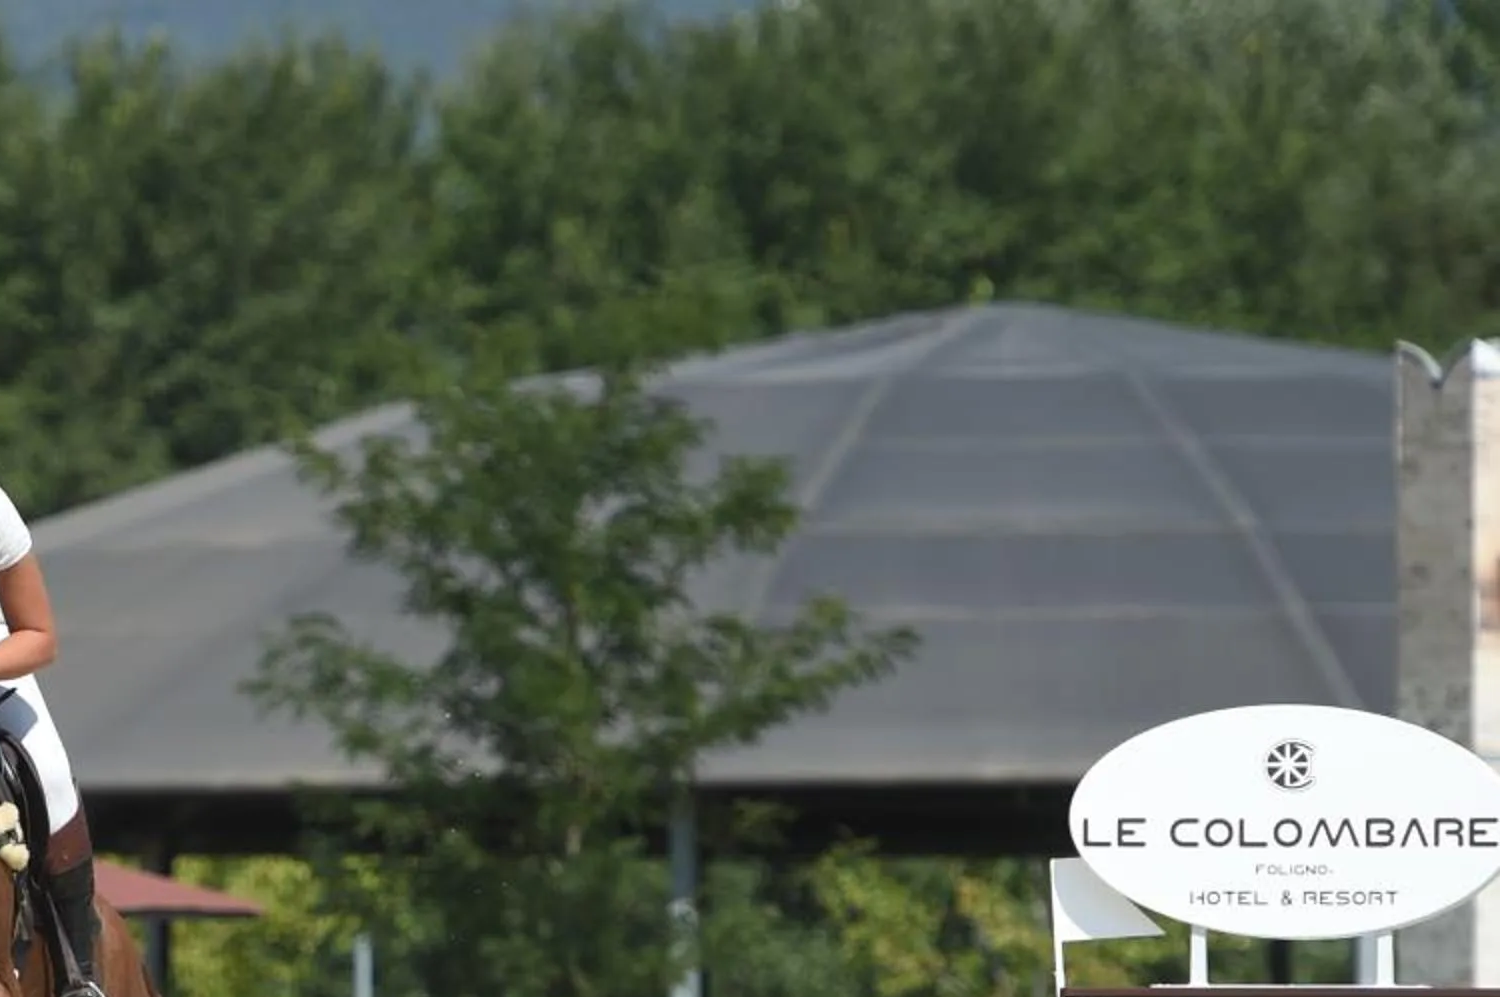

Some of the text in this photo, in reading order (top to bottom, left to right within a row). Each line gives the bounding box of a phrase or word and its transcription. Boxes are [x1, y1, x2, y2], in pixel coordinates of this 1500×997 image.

[1083, 817, 1499, 848] LE COLOMBARE
[1189, 889, 1399, 907] HOTEL & RESORT
